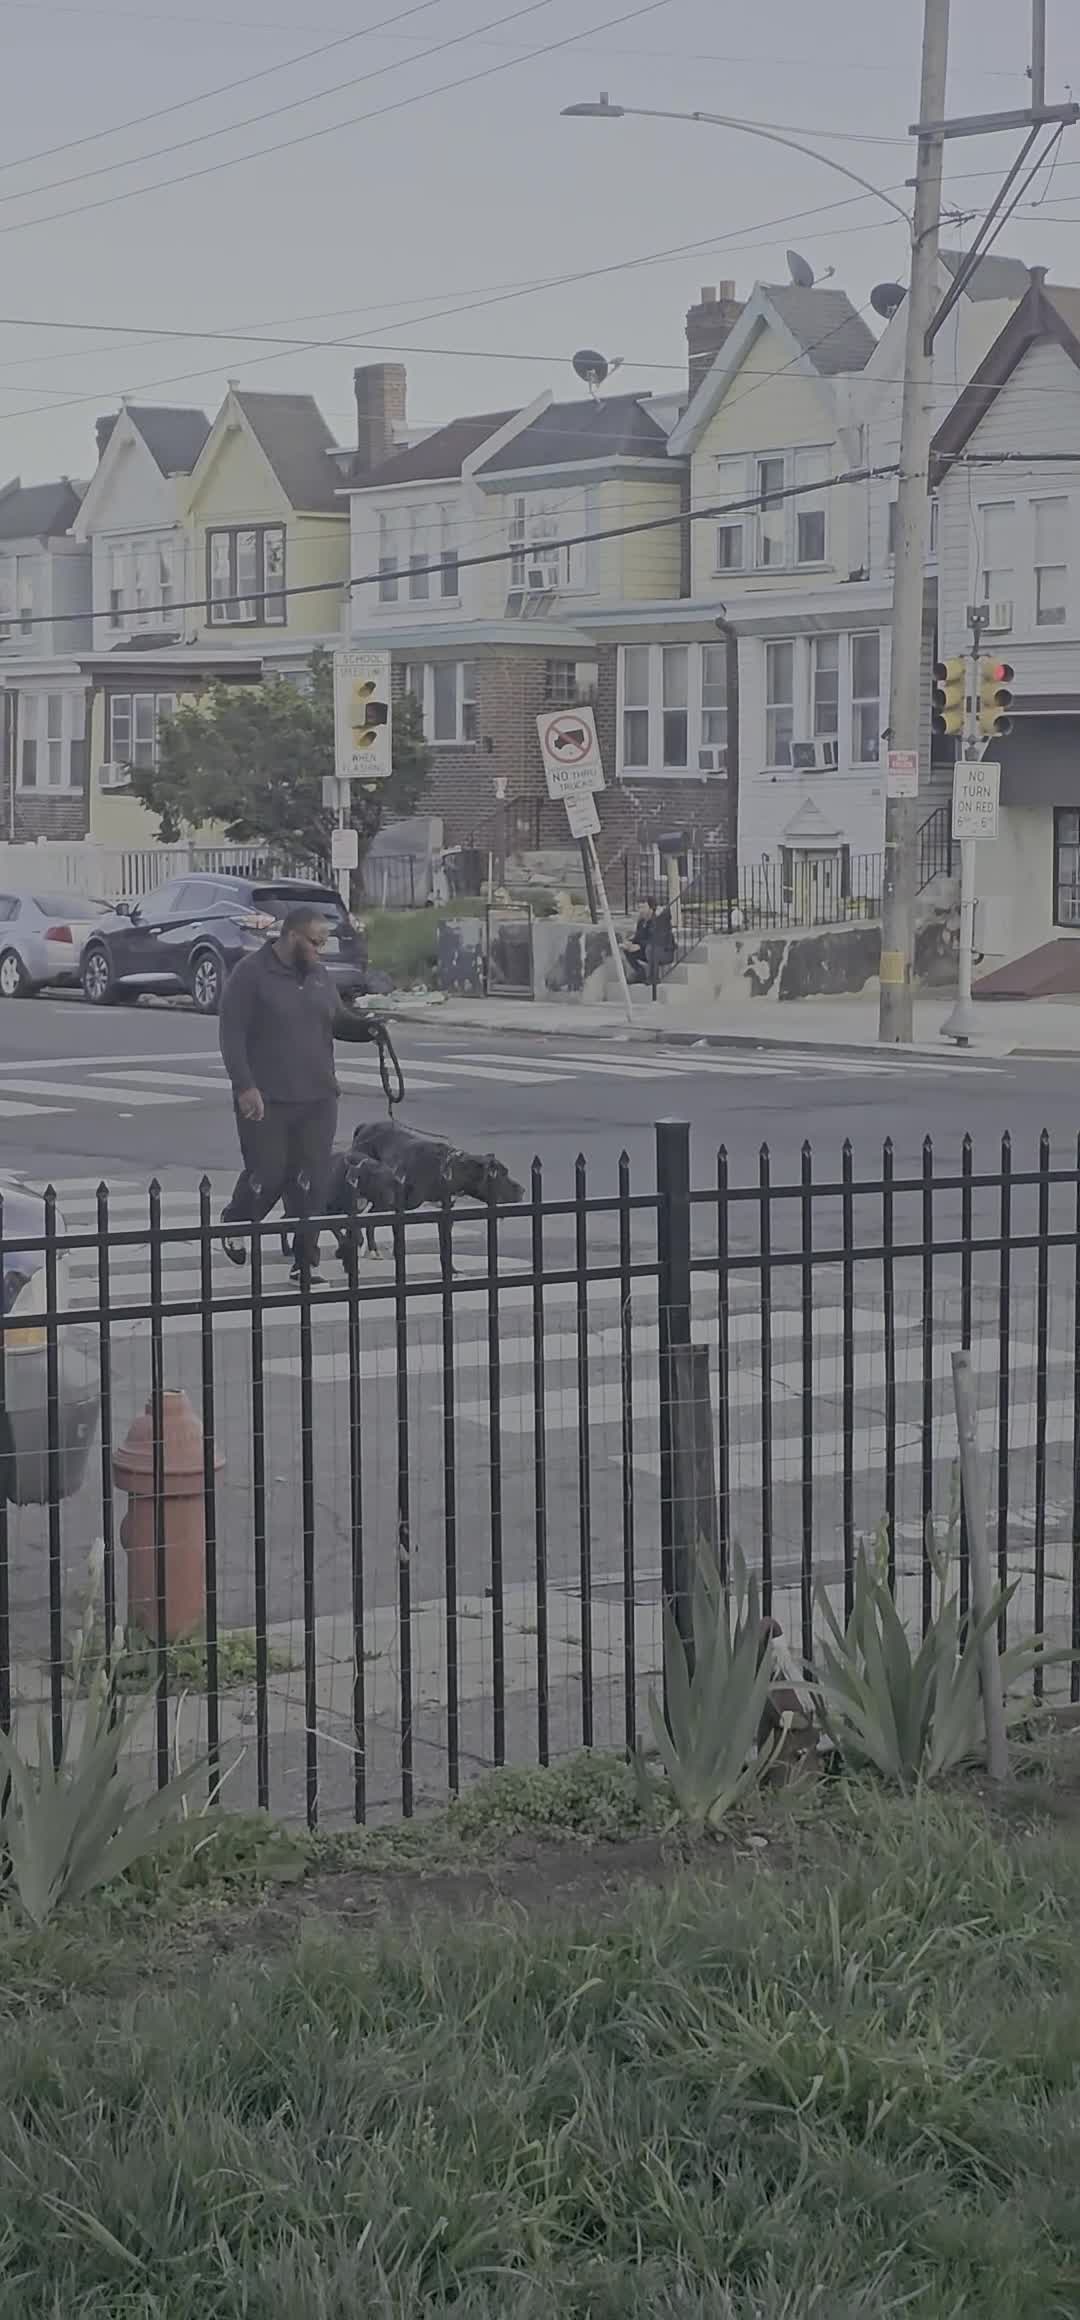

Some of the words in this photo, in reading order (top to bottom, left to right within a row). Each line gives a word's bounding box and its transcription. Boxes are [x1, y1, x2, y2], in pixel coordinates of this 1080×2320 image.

[343, 655, 384, 664] SCHOOL
[352, 752, 377, 762] WHEN
[552, 770, 569, 783] NO
[573, 767, 597, 779] THRU
[968, 771, 985, 782] NO
[559, 779, 593, 792] TRUCKS
[962, 785, 991, 797] TURN
[959, 801, 972, 812] ON
[976, 801, 993, 813] RED
